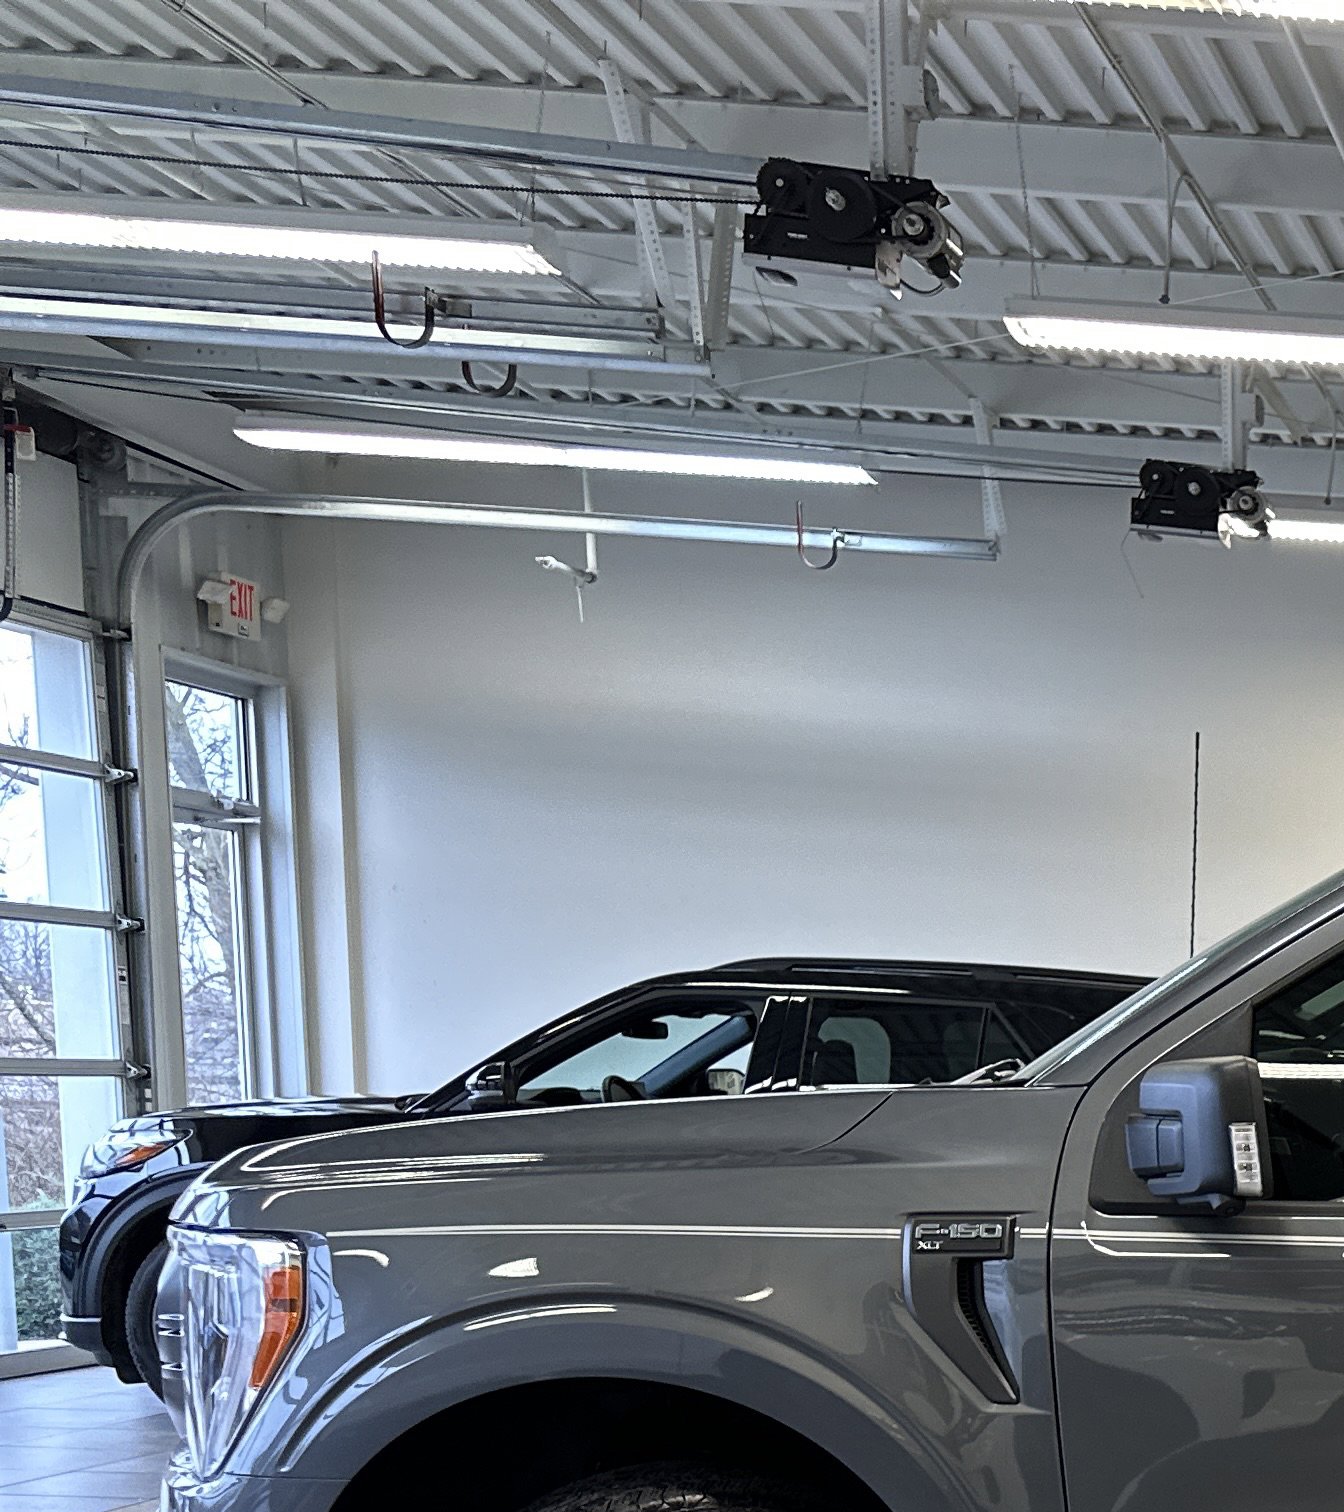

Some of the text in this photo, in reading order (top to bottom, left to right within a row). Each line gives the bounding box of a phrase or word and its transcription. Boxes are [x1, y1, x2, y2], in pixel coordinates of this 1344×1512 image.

[230, 579, 254, 621] EXIT
[914, 1223, 1003, 1239] F-150
[916, 1240, 944, 1250] XLT
